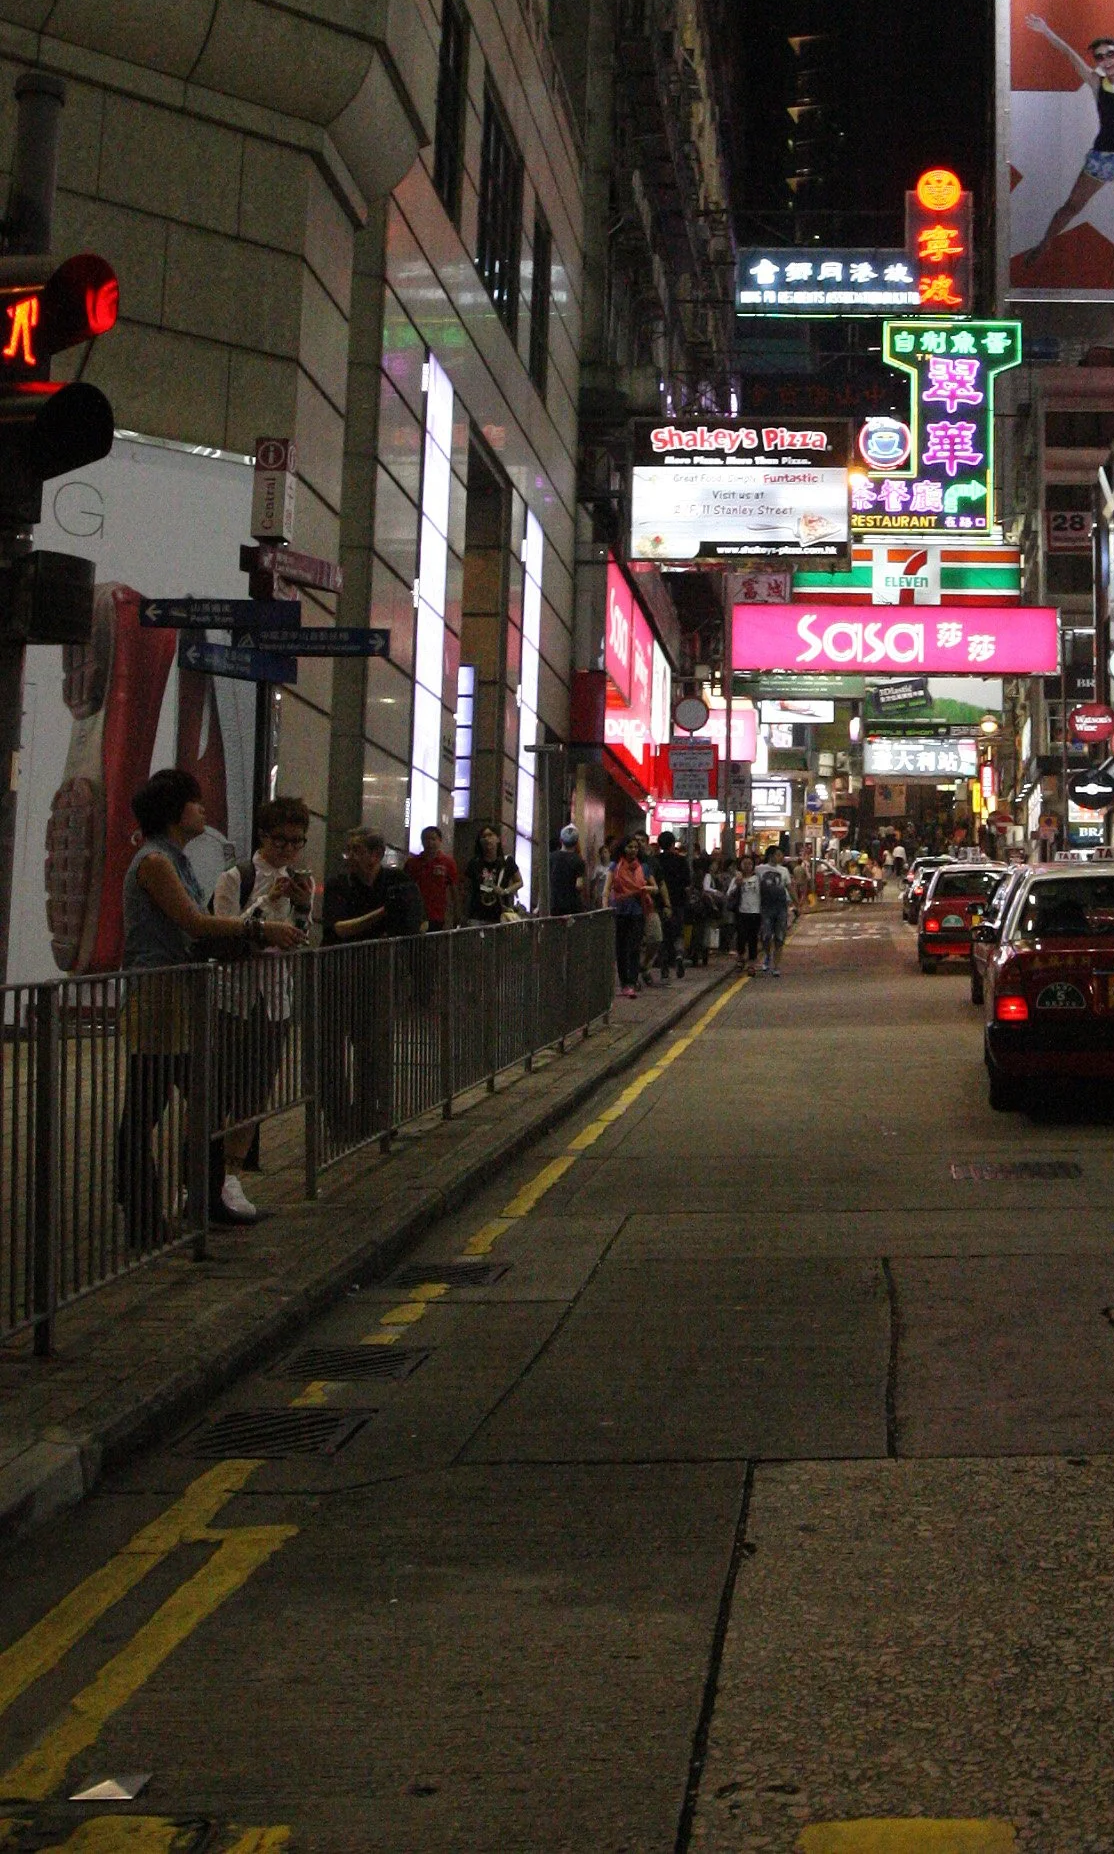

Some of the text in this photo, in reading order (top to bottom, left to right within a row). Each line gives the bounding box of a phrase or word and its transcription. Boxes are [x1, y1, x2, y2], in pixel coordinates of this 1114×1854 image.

[922, 357, 984, 477] 翠華
[650, 426, 828, 453] Shakey's Pizza
[664, 456, 691, 465] More
[781, 457, 812, 465] Pizza.
[713, 490, 736, 499] Visit
[754, 491, 765, 499] at
[262, 477, 276, 530] Central
[713, 504, 754, 516] Stanley
[758, 504, 793, 515] Street
[851, 515, 938, 528] RESTAURANT
[1053, 514, 1085, 532] 28
[936, 621, 996, 663] 莎莎
[1075, 714, 1113, 724] Watson's
[1075, 723, 1098, 732] Wine
[1059, 852, 1081, 860] TAXI
